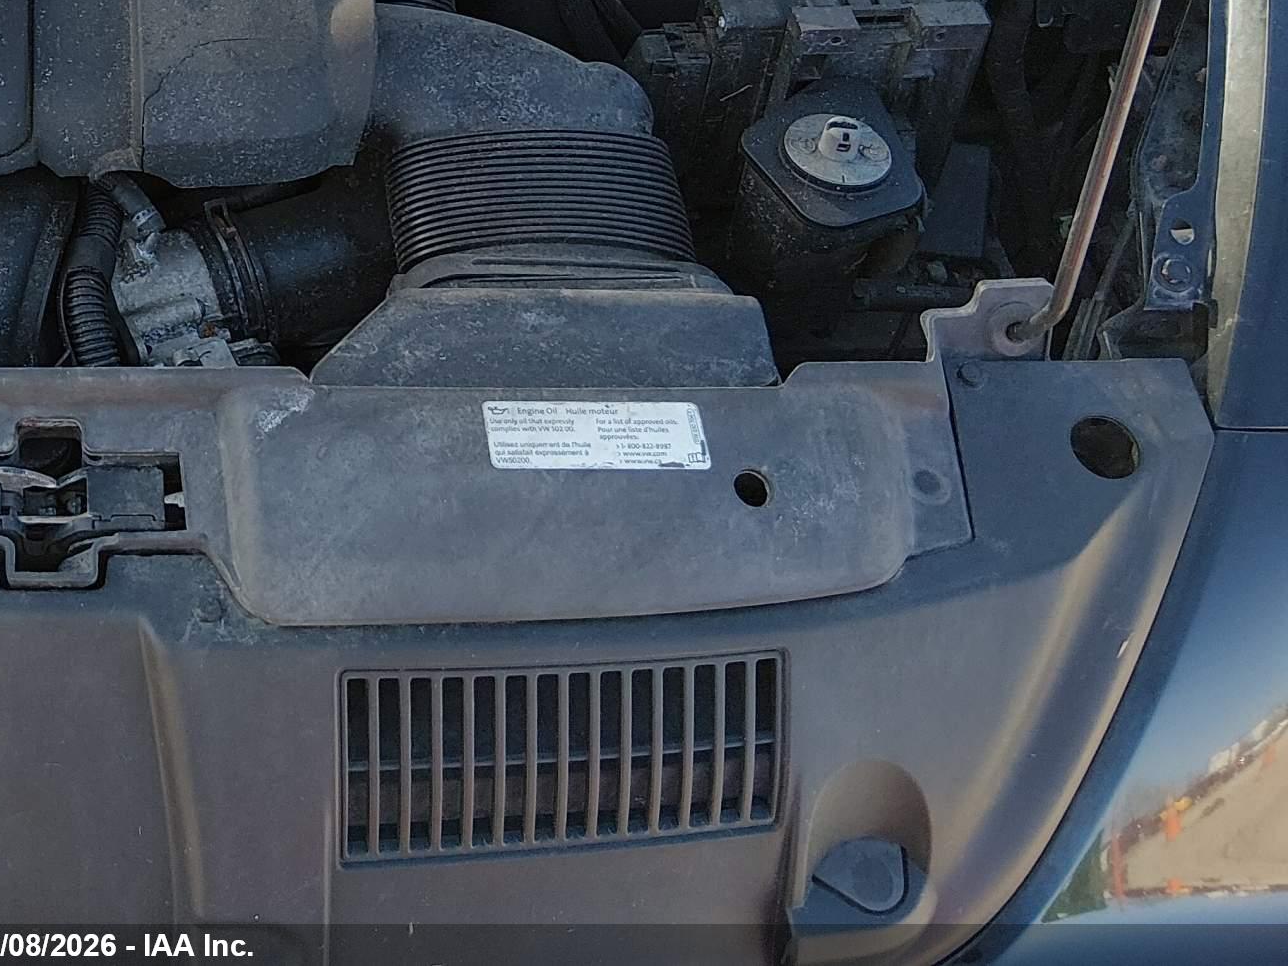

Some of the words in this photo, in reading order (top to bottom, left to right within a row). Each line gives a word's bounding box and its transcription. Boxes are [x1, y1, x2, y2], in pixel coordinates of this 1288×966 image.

[517, 407, 545, 417] Engine
[546, 407, 558, 415] Oil
[565, 407, 587, 415] Huile
[588, 407, 619, 415] moteur
[633, 418, 664, 426] approved
